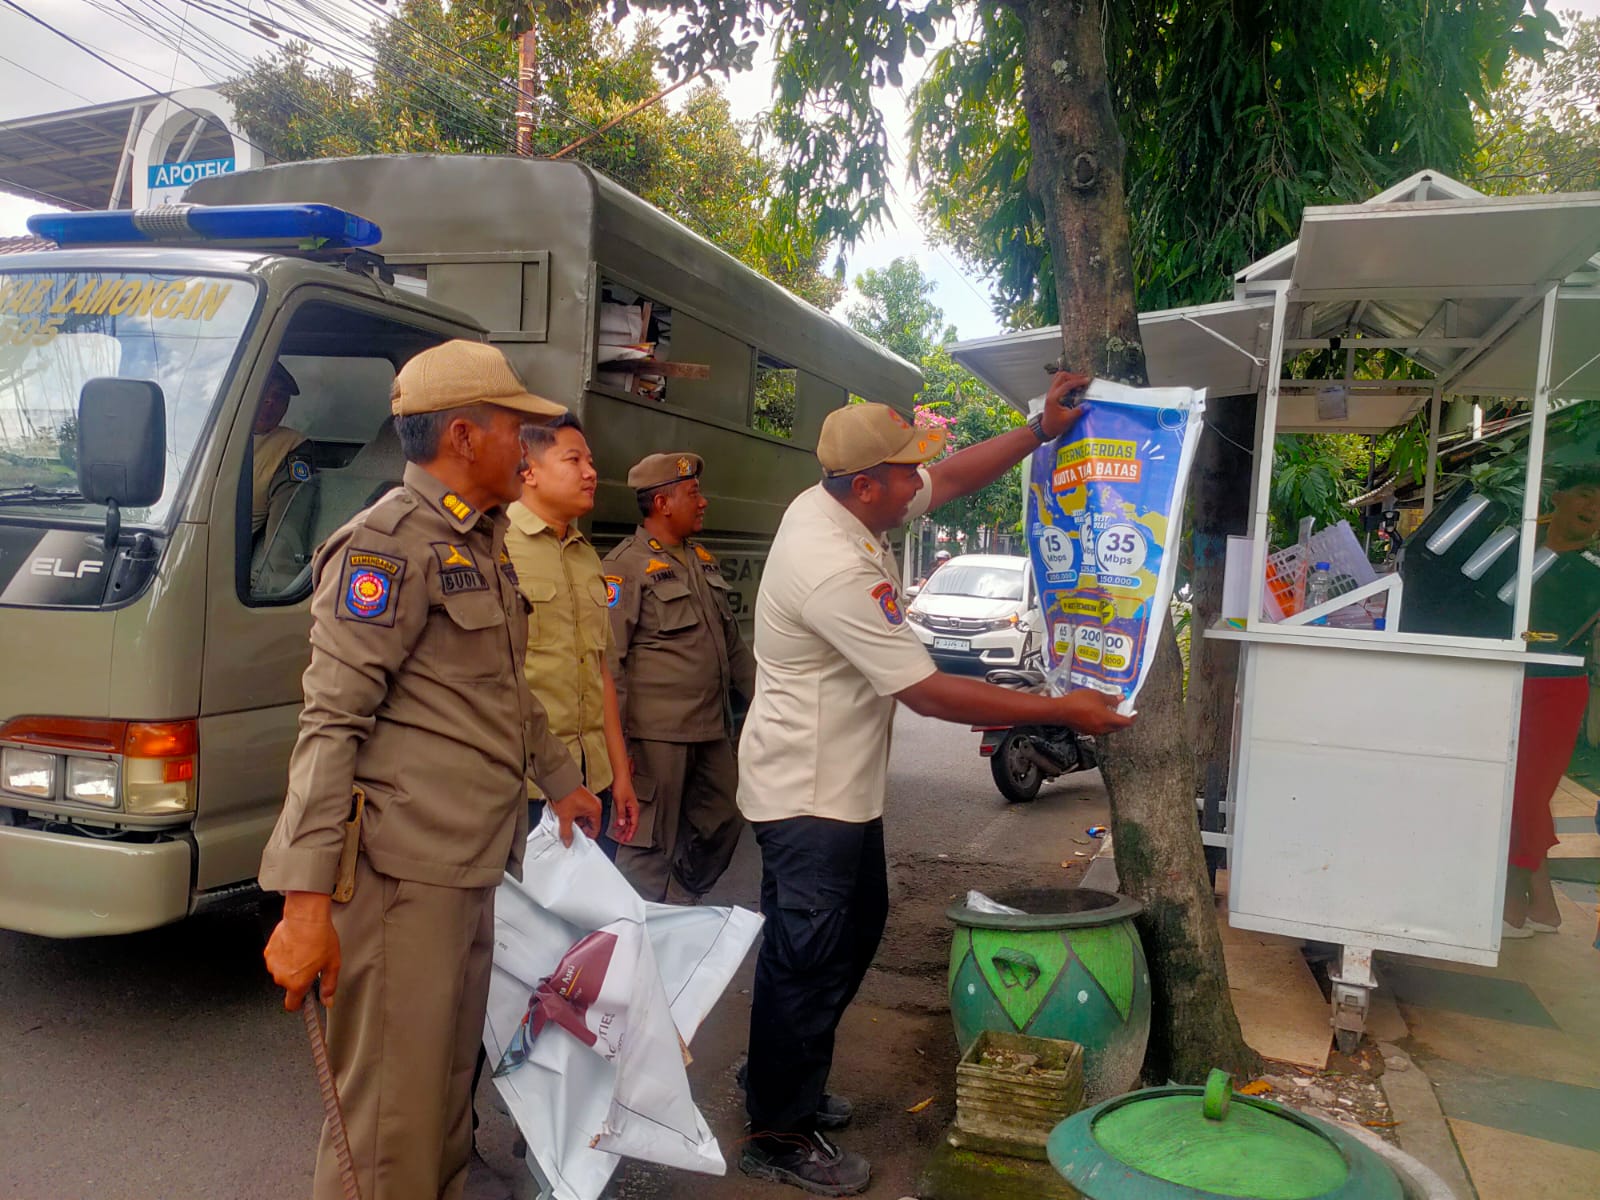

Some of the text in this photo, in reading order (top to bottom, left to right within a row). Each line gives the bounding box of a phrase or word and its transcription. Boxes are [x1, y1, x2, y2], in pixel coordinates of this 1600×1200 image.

[155, 161, 230, 186] APOTEK
[50, 278, 232, 321] LAMONGAN
[1085, 443, 1132, 458] CERDAS
[1053, 466, 1077, 486] KUOTA
[1096, 462, 1137, 476] BATAS
[1044, 535, 1061, 552] 15
[1106, 533, 1135, 553] 35
[1047, 554, 1067, 562] Mbps
[1103, 554, 1132, 565] Mbps
[31, 557, 104, 578] ELF
[1100, 575, 1132, 586] 150.000
[1081, 629, 1100, 642] 200
